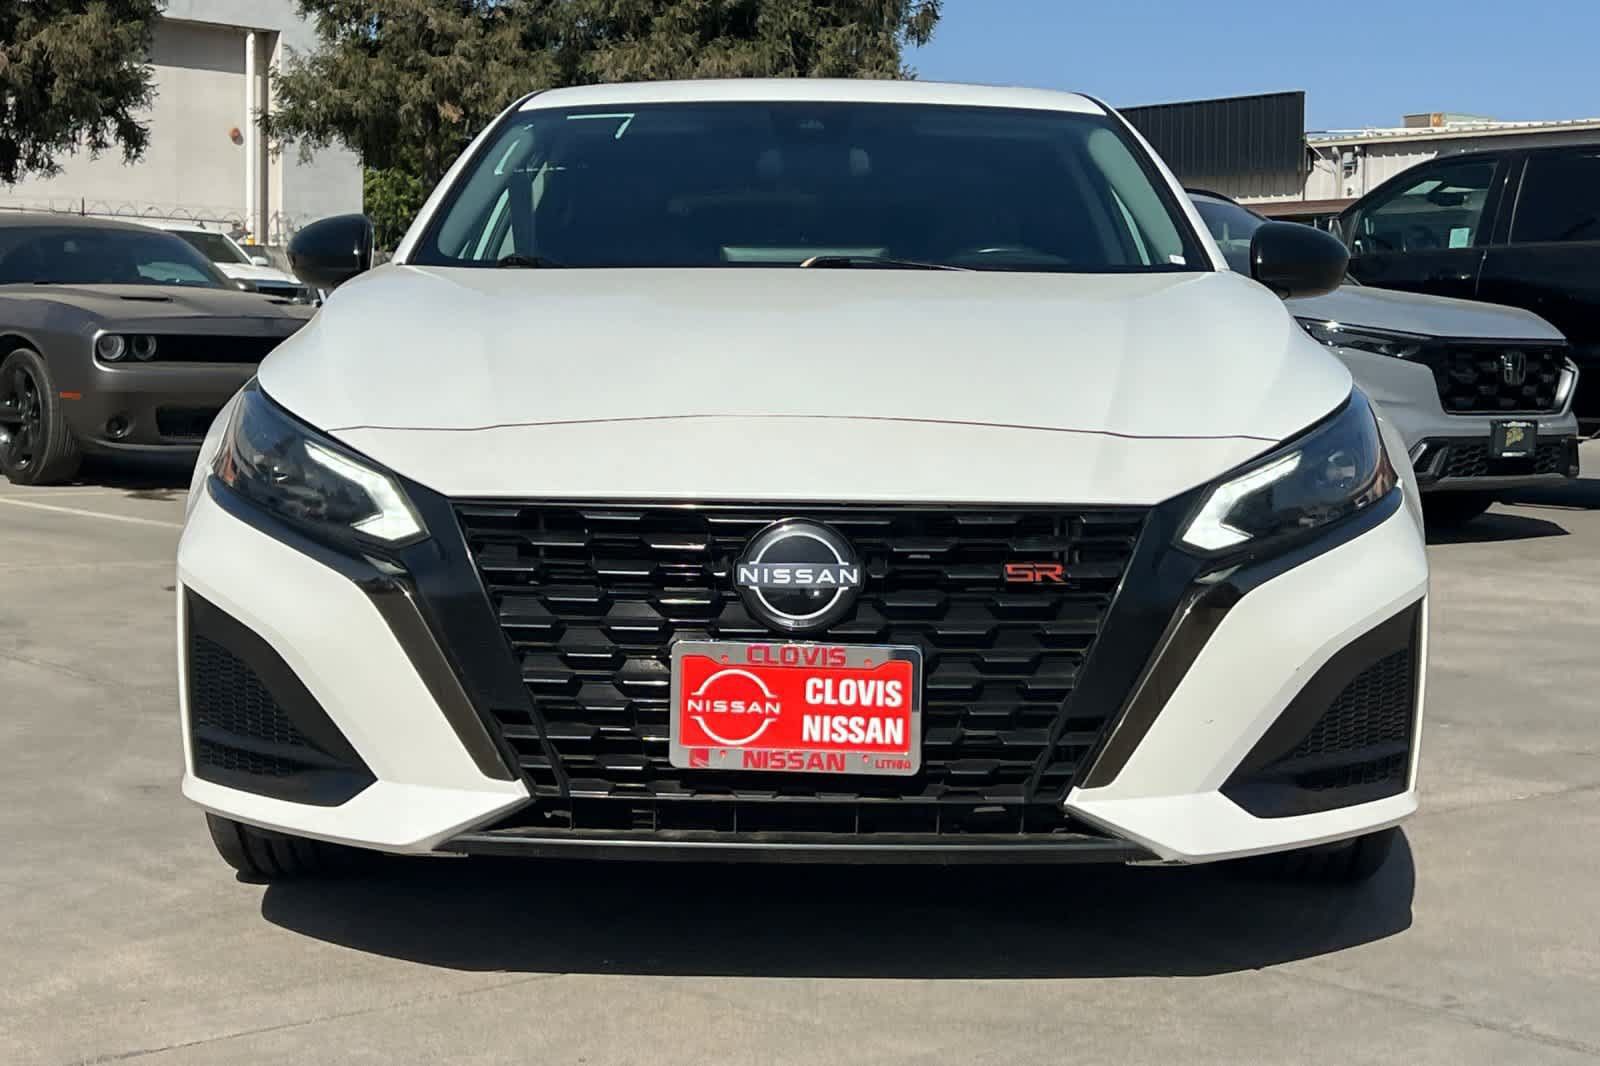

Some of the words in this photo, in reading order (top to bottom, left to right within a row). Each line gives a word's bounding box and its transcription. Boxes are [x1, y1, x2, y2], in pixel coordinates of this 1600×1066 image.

[740, 567, 858, 584] NISSAN
[1004, 563, 1065, 583] SR
[746, 645, 846, 667] CLOVIS
[805, 677, 903, 707] CLOVIS
[687, 699, 780, 714] NISSAN
[802, 714, 904, 745] NISSAN
[743, 751, 845, 771] NISSAN
